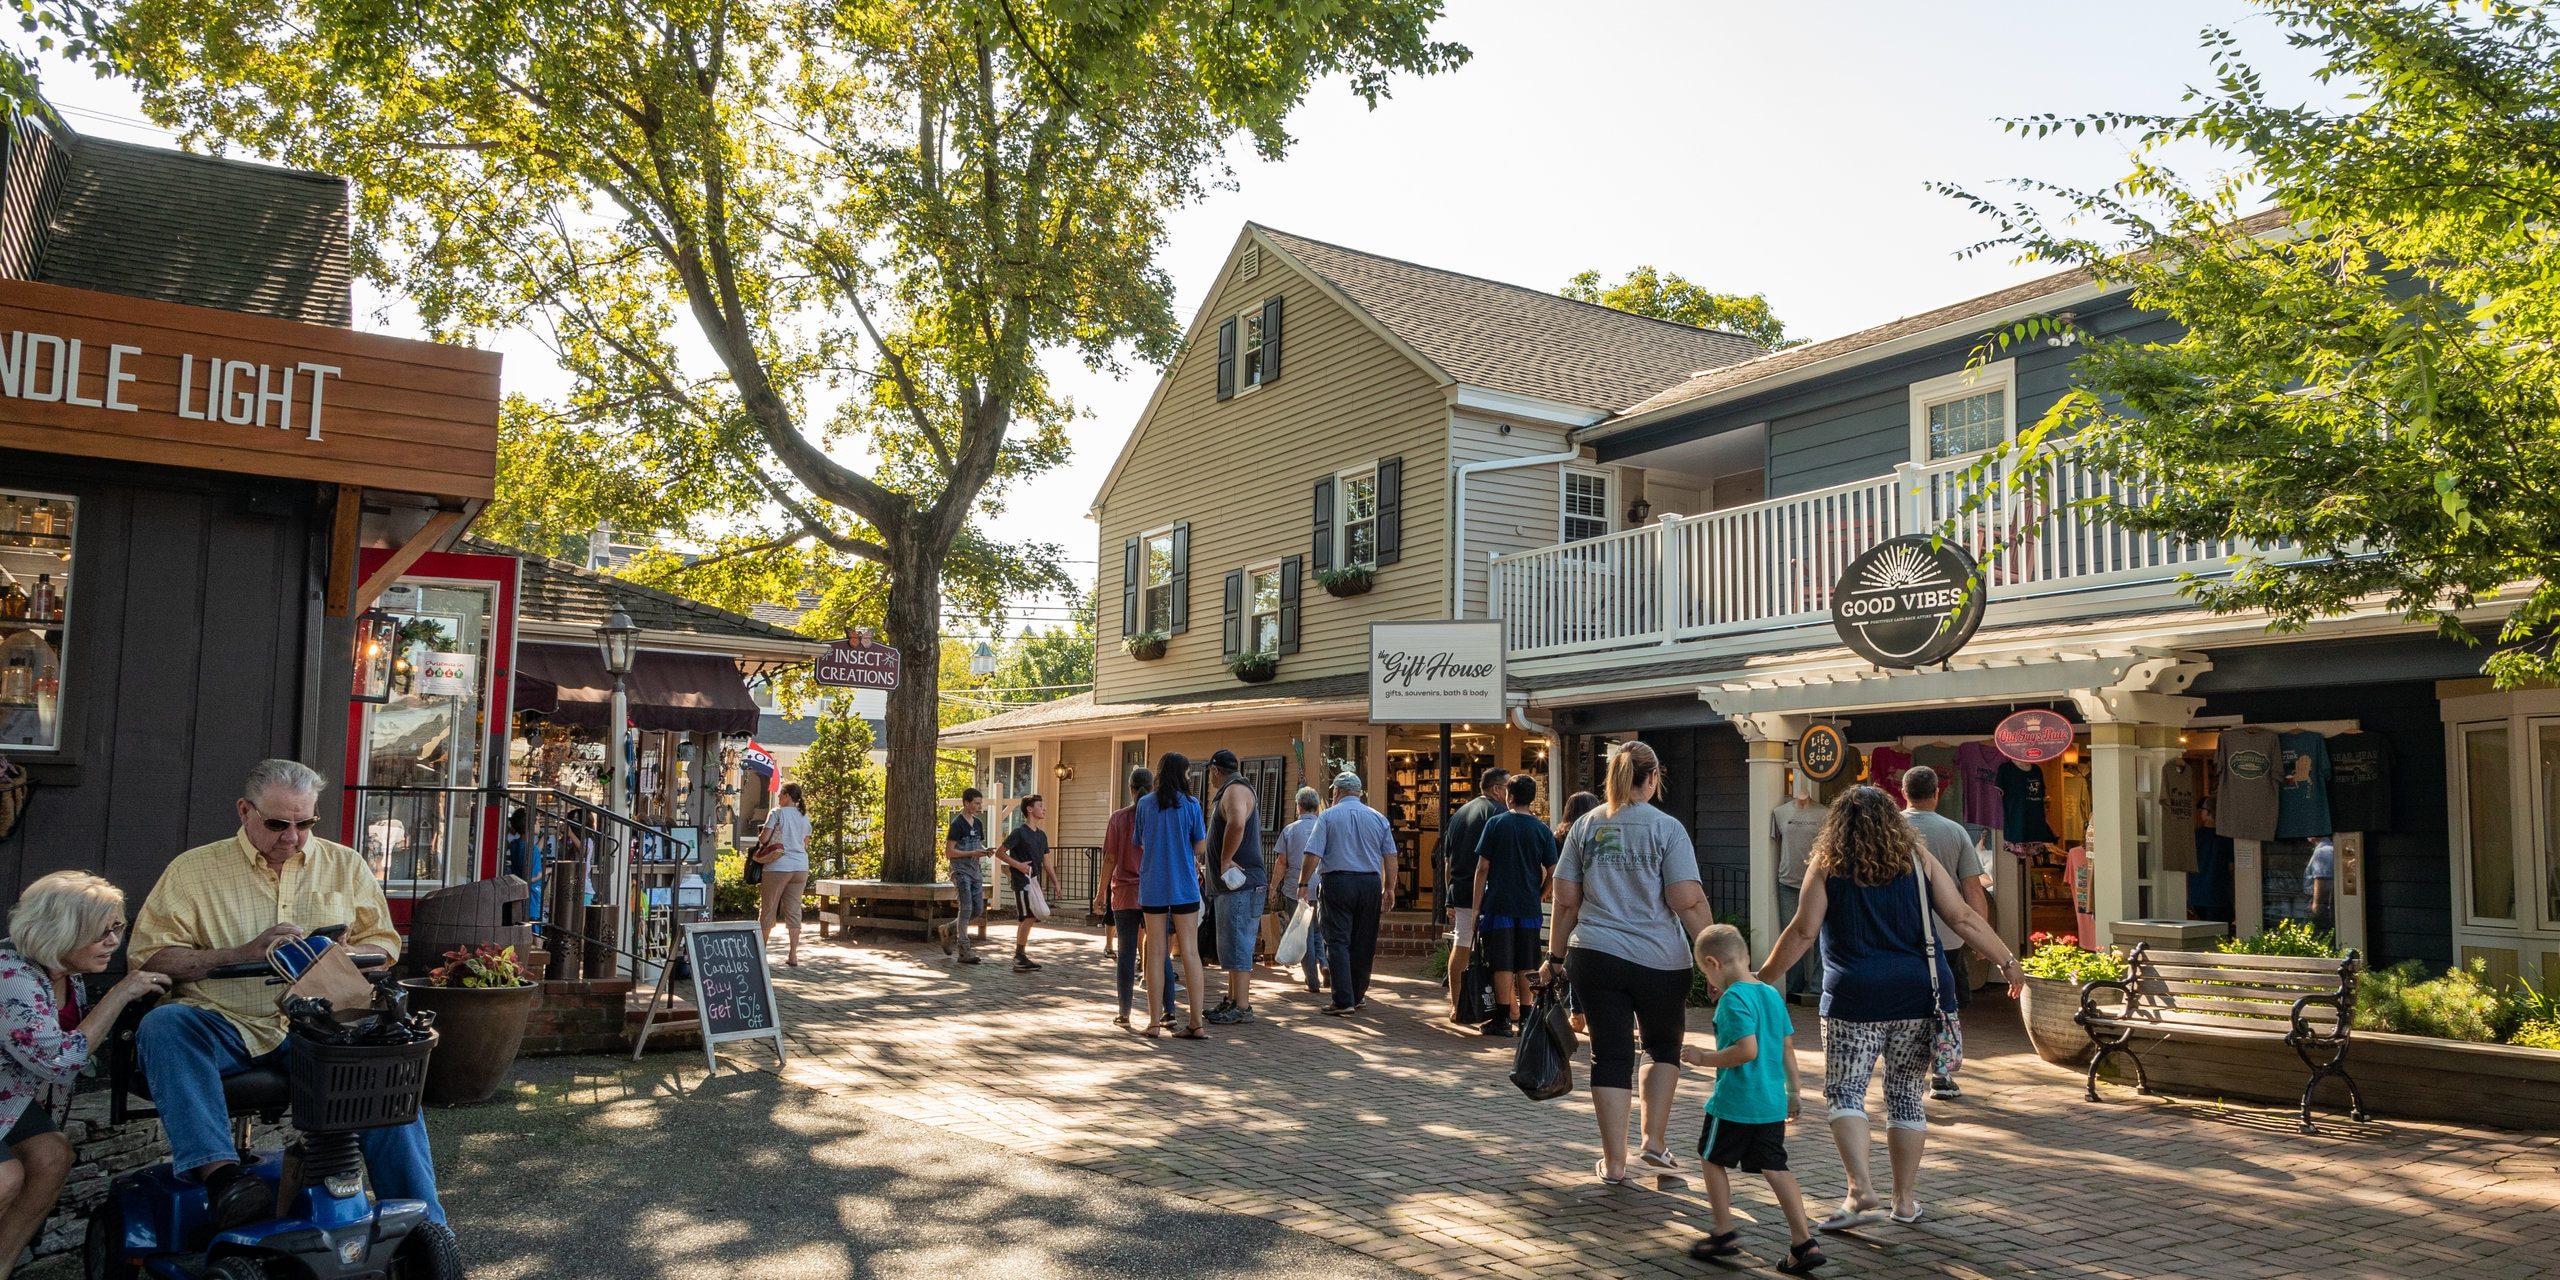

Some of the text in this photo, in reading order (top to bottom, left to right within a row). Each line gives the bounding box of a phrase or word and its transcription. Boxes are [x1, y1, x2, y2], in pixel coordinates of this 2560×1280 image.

[179, 353, 342, 442] LIGHT
[1841, 588, 1962, 617] GOOD VIBES
[835, 648, 882, 667] INSECT
[820, 666, 894, 685] CREATIONS
[1378, 650, 1496, 687] the Gift House
[1385, 689, 1403, 698] gifts,
[1470, 689, 1489, 698] body
[1811, 734, 1830, 747] Life
[1818, 745, 1826, 753] is
[1808, 751, 1834, 765] good.
[1597, 854, 1658, 863] GREEN HOUSE
[698, 935, 754, 959] Barrick
[703, 960, 749, 977] Candles
[703, 974, 749, 1000] Buy 3
[708, 993, 760, 1019] Get 15%
